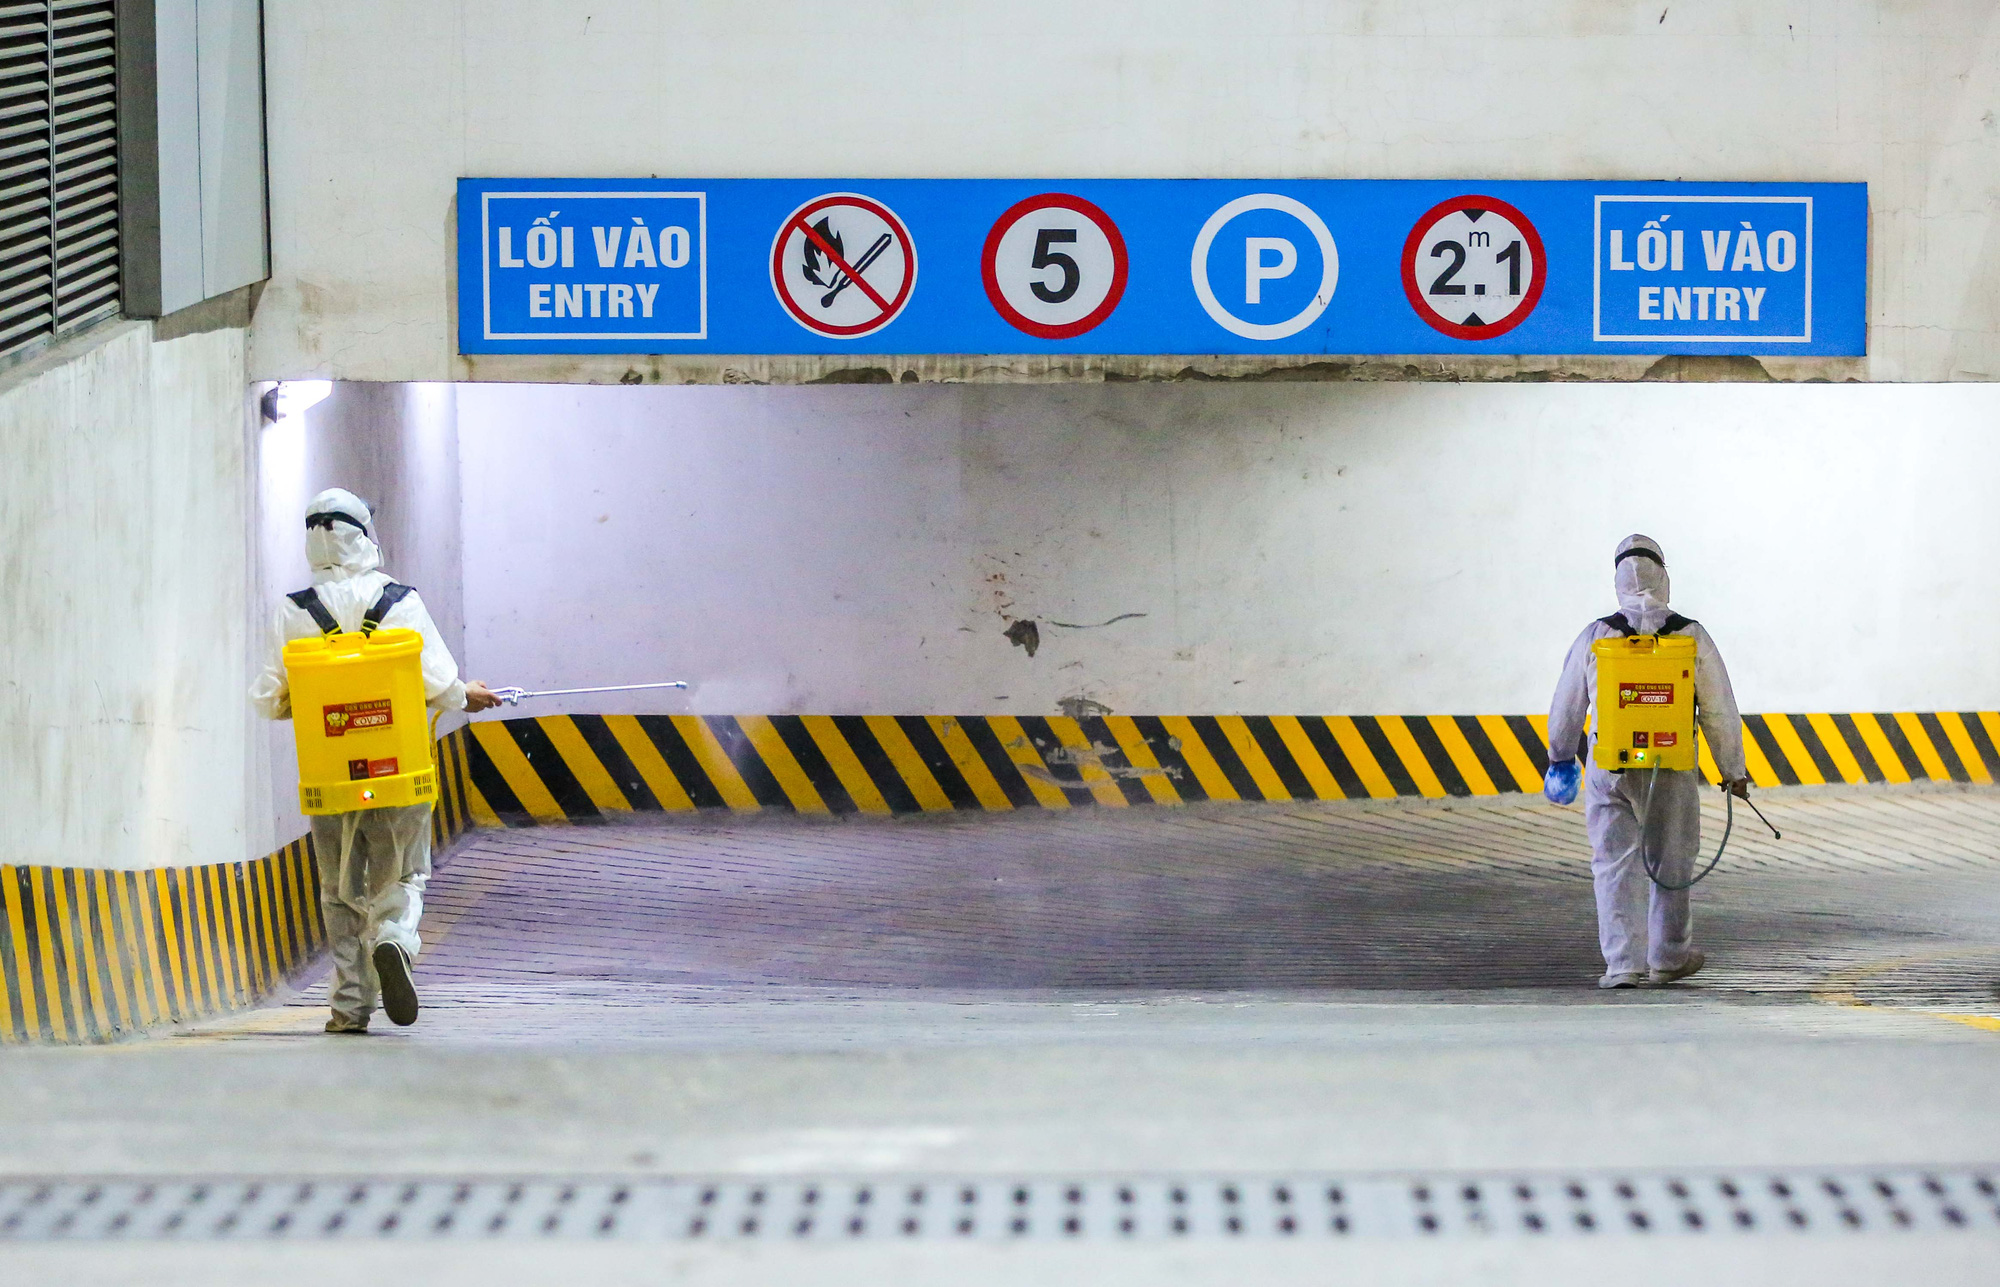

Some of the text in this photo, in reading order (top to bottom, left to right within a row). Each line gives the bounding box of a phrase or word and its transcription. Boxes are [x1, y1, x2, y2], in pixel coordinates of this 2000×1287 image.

[498, 211, 690, 269] LỐI VÀO
[1029, 228, 1081, 304] 5
[1428, 240, 1521, 296] 2.1
[1468, 231, 1490, 248] m
[1609, 214, 1797, 273] LỐI VÀO
[1245, 237, 1298, 304] P
[529, 283, 660, 318] ENTRY
[1638, 286, 1767, 321] ENTRY
